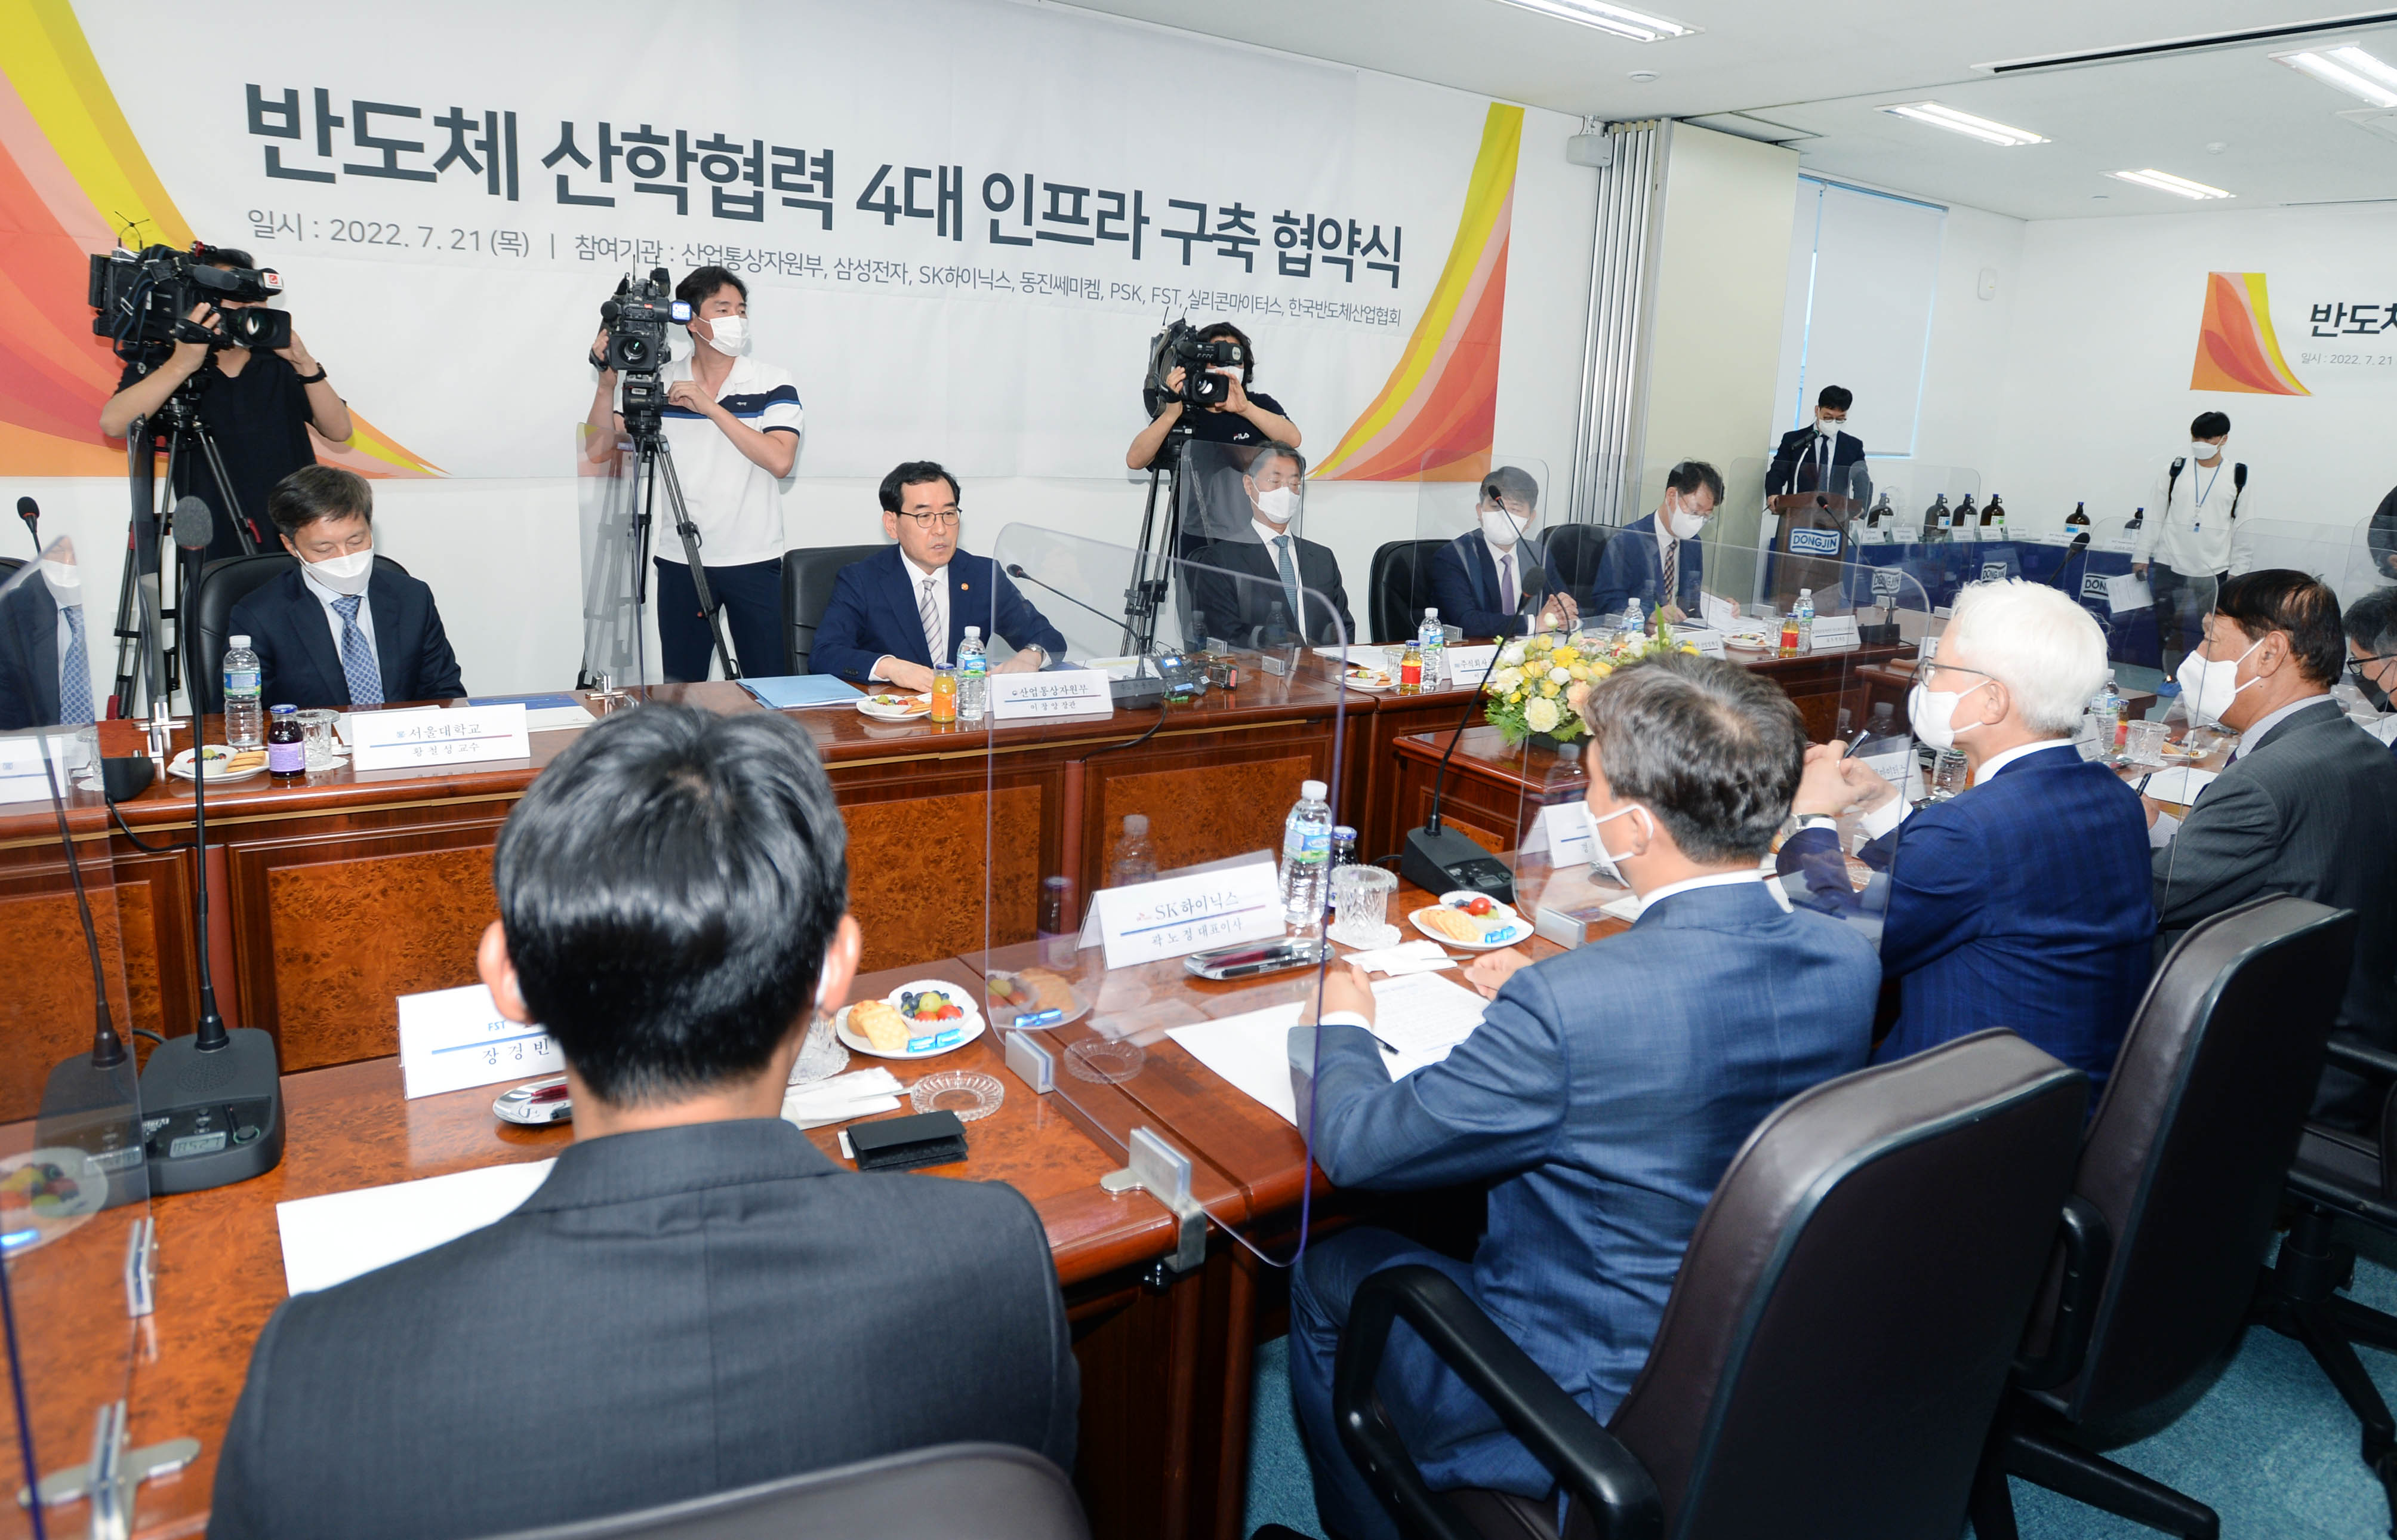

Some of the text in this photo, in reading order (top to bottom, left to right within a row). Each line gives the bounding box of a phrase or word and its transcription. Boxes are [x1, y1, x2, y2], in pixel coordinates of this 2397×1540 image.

[246, 83, 1402, 288] 반도체 산학협력 4대 인프라 구축 협약식
[248, 210, 303, 241] 일시
[330, 218, 409, 248] 2022.
[417, 226, 442, 250] 7.
[575, 234, 664, 265] 참여기관
[681, 243, 828, 279] 산업통상자원부,
[834, 257, 913, 285] 삼성전자,
[919, 265, 1015, 293] SK하이닉스,
[1019, 272, 1104, 301] 동진쎄미켐,
[1110, 282, 1145, 304] PSK,
[1151, 287, 1182, 309] FST,
[1187, 289, 1285, 317] 실리콘마이터스,
[1289, 297, 1401, 327] 한국반도체산업협회
[1233, 432, 1250, 441] FILA
[1793, 535, 1837, 548] DONGJIN
[1019, 684, 1089, 698] 산업통상자원부
[410, 723, 482, 740] 서울대학교
[1155, 891, 1239, 920] SK하이닉스
[1198, 917, 1243, 939] 대표이사
[488, 1020, 507, 1032] FST
